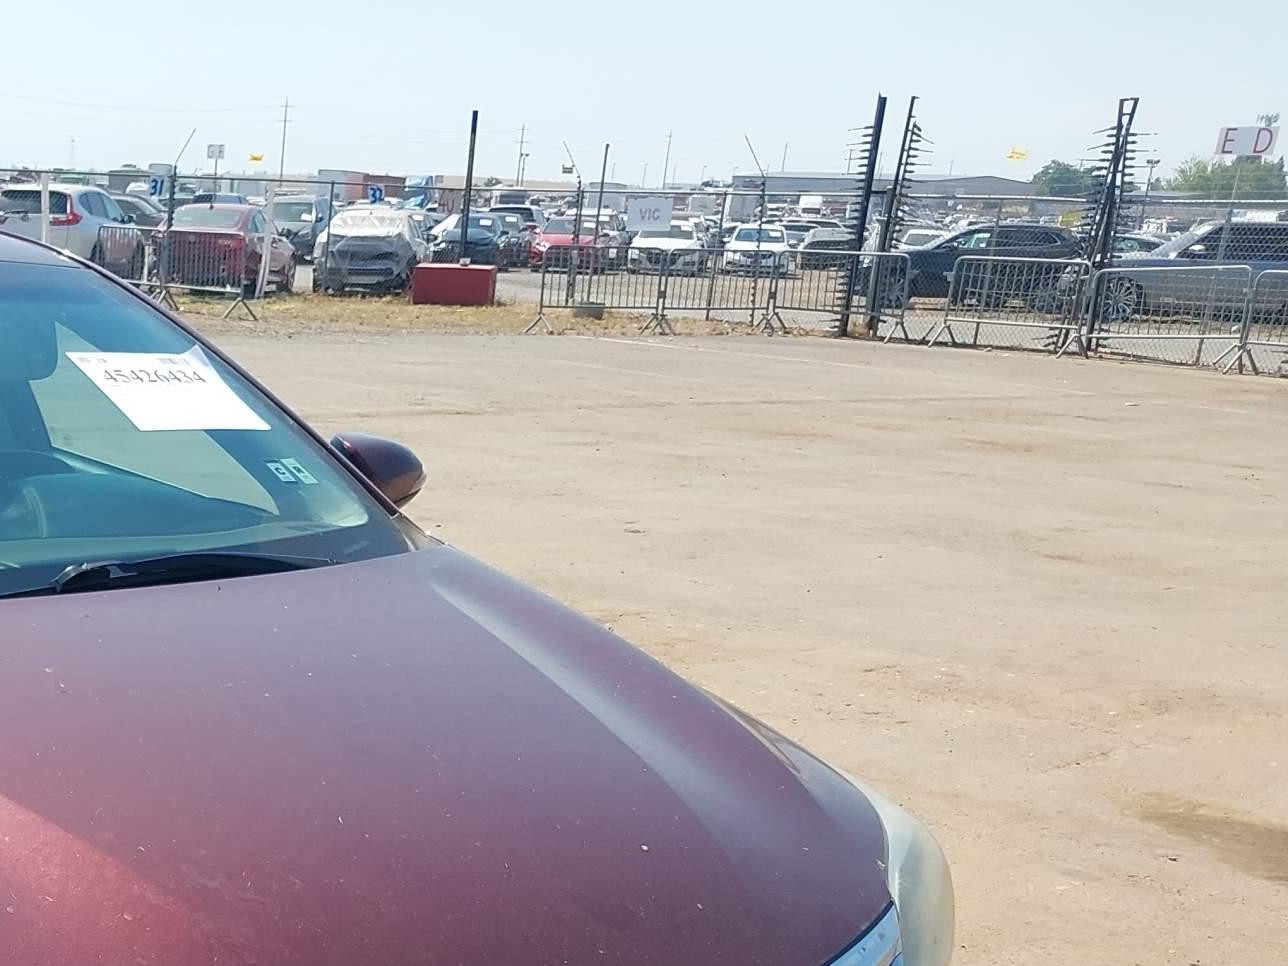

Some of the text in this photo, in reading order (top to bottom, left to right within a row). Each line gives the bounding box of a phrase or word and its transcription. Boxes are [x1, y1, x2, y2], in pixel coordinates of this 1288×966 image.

[1221, 127, 1273, 154] E D
[149, 178, 165, 196] 31
[639, 207, 661, 221] VIC
[103, 369, 207, 383] 45426434
